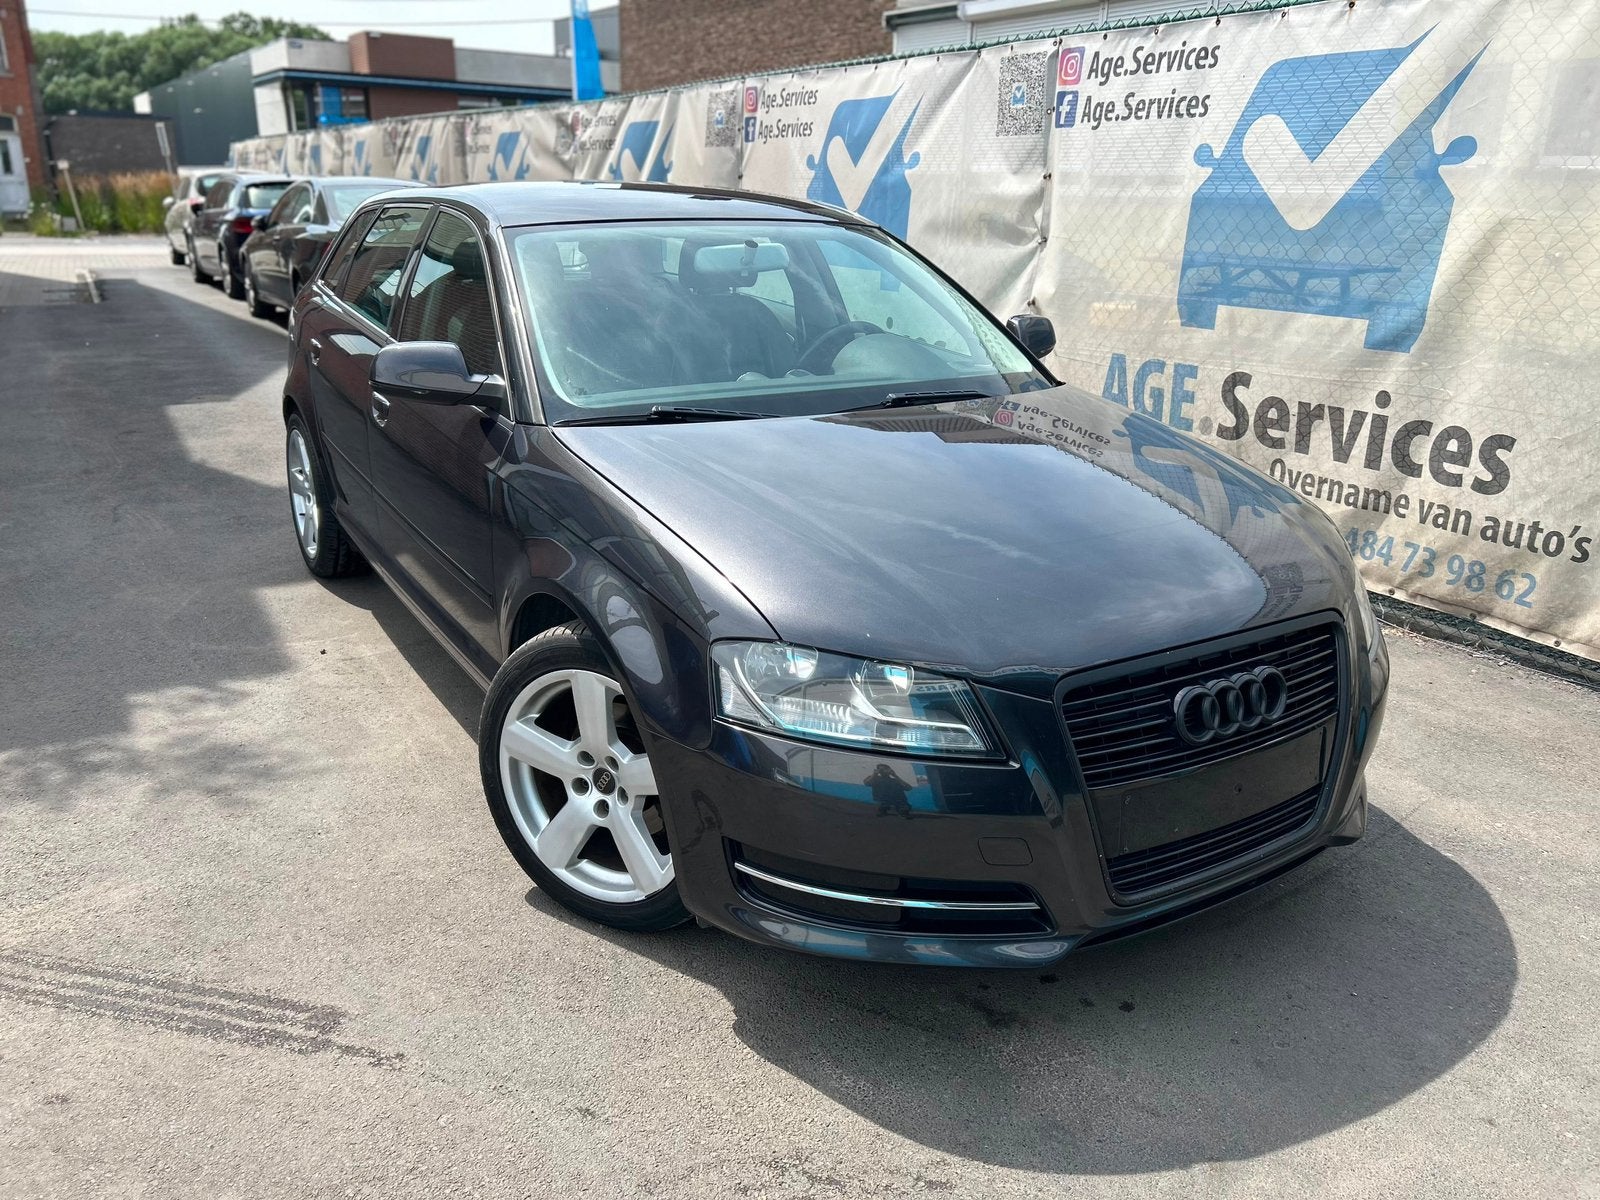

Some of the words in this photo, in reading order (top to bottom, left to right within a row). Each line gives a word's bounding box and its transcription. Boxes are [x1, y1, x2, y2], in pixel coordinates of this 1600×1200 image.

[1087, 41, 1220, 86] Age.Services
[760, 85, 819, 114] Age.Services
[1080, 88, 1211, 130] Age.Services
[758, 118, 814, 144] Age.Services
[1269, 458, 1411, 519] Overname
[1418, 498, 1473, 537] van
[1400, 541, 1437, 578] 73
[1446, 554, 1486, 592] 98
[1494, 569, 1537, 609] 62
